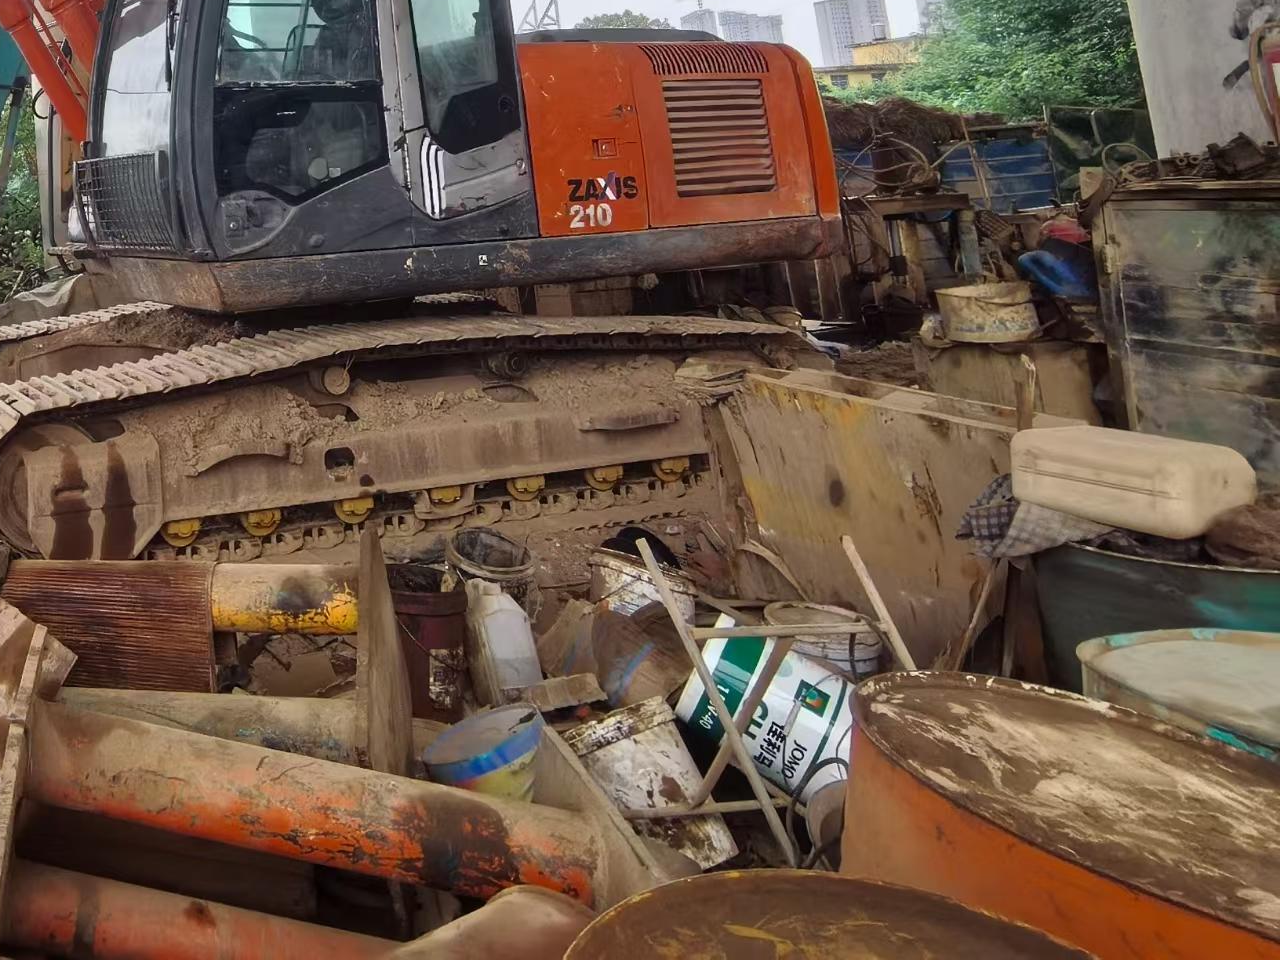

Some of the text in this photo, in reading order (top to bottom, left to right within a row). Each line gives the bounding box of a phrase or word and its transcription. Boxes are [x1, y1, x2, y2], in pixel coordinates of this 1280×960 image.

[567, 171, 639, 201] ZAXIS
[569, 203, 612, 228] 210
[784, 740, 807, 779] JOMO
